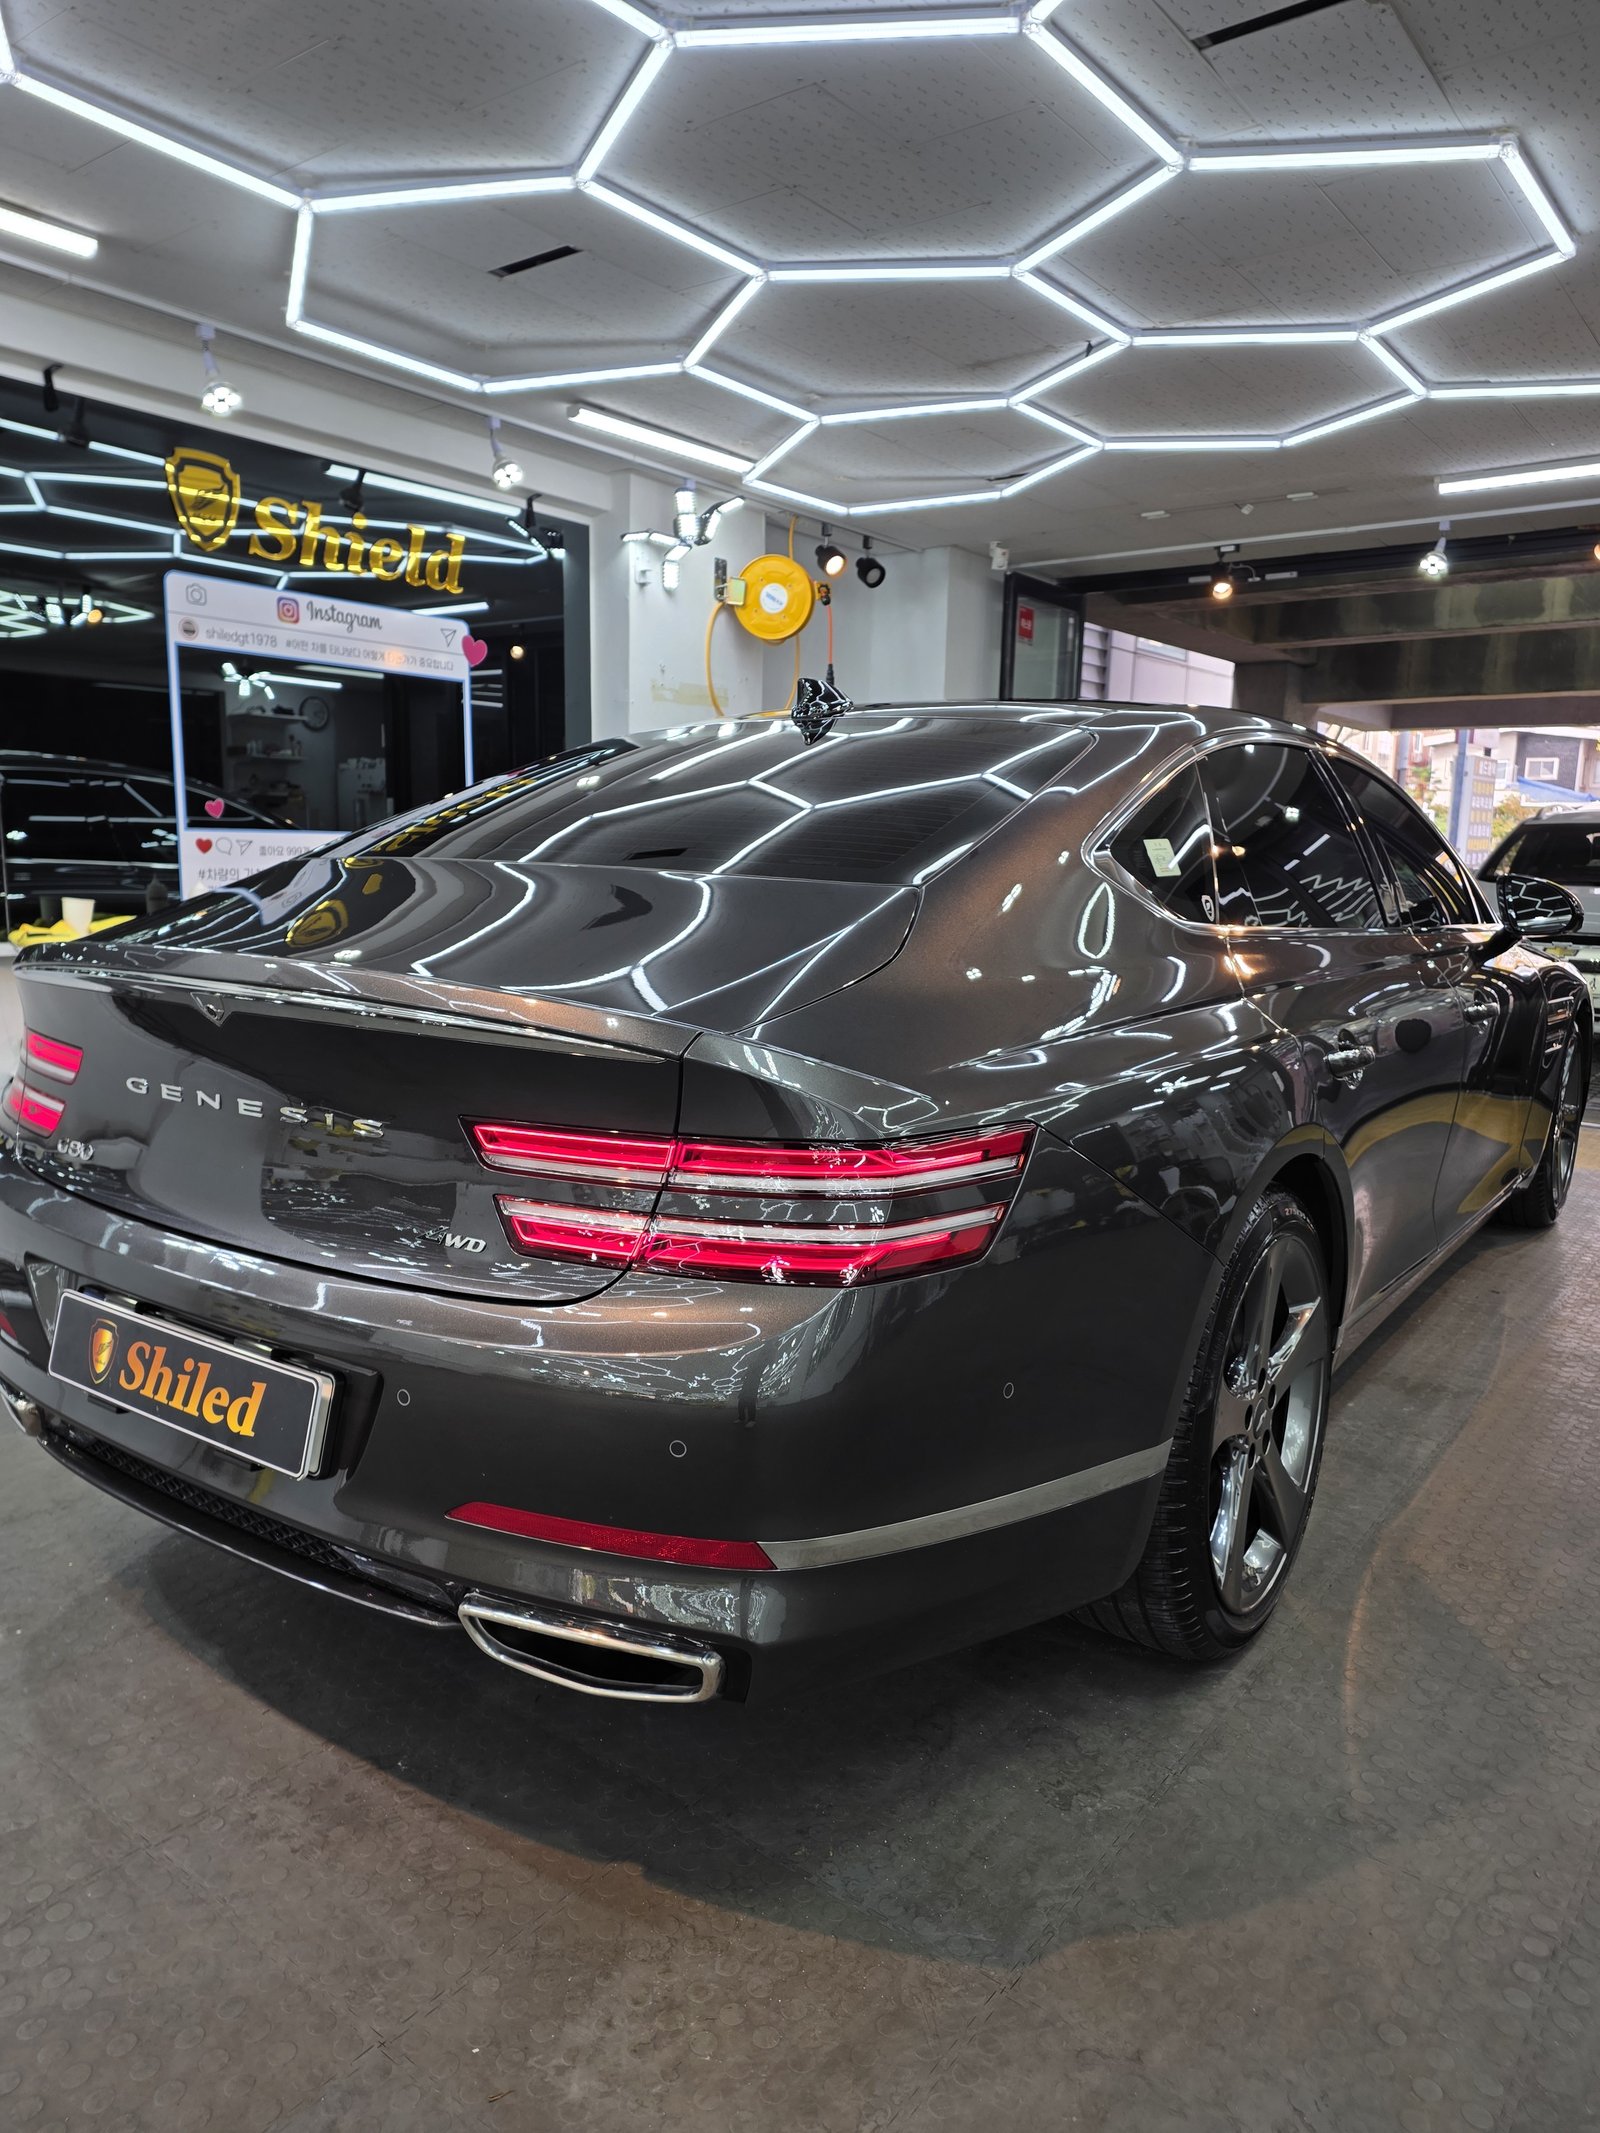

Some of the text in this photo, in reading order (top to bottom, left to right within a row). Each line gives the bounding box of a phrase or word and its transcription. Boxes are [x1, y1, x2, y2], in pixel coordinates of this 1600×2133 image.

[248, 496, 466, 594] Shield
[306, 600, 383, 633] Instagram
[126, 1077, 384, 1138] GENESIS
[416, 1225, 487, 1253] 4WD
[118, 1341, 267, 1438] Shiled
